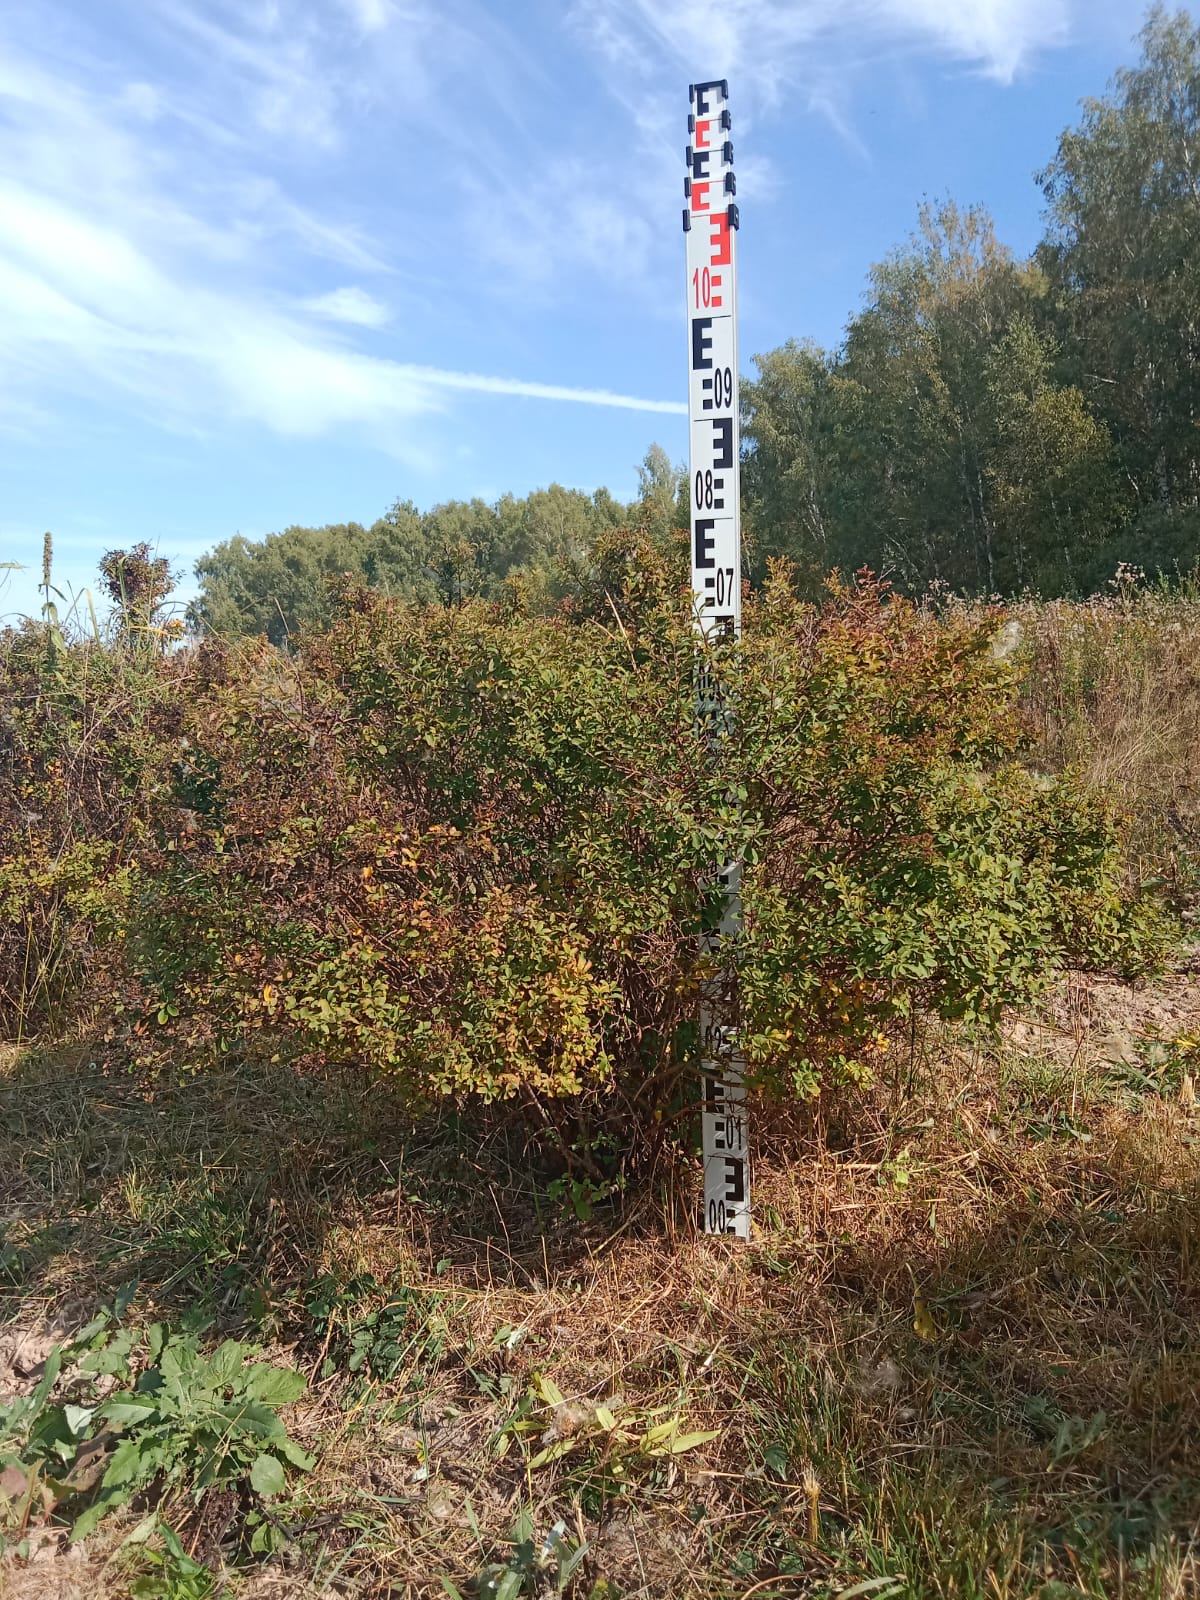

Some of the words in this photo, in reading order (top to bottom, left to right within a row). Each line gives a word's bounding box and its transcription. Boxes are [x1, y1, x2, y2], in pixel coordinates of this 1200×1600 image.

[692, 266, 711, 309] 10
[714, 366, 732, 409] 09
[695, 469, 713, 510] 08
[716, 567, 734, 607] 07
[709, 1199, 725, 1233] 00
